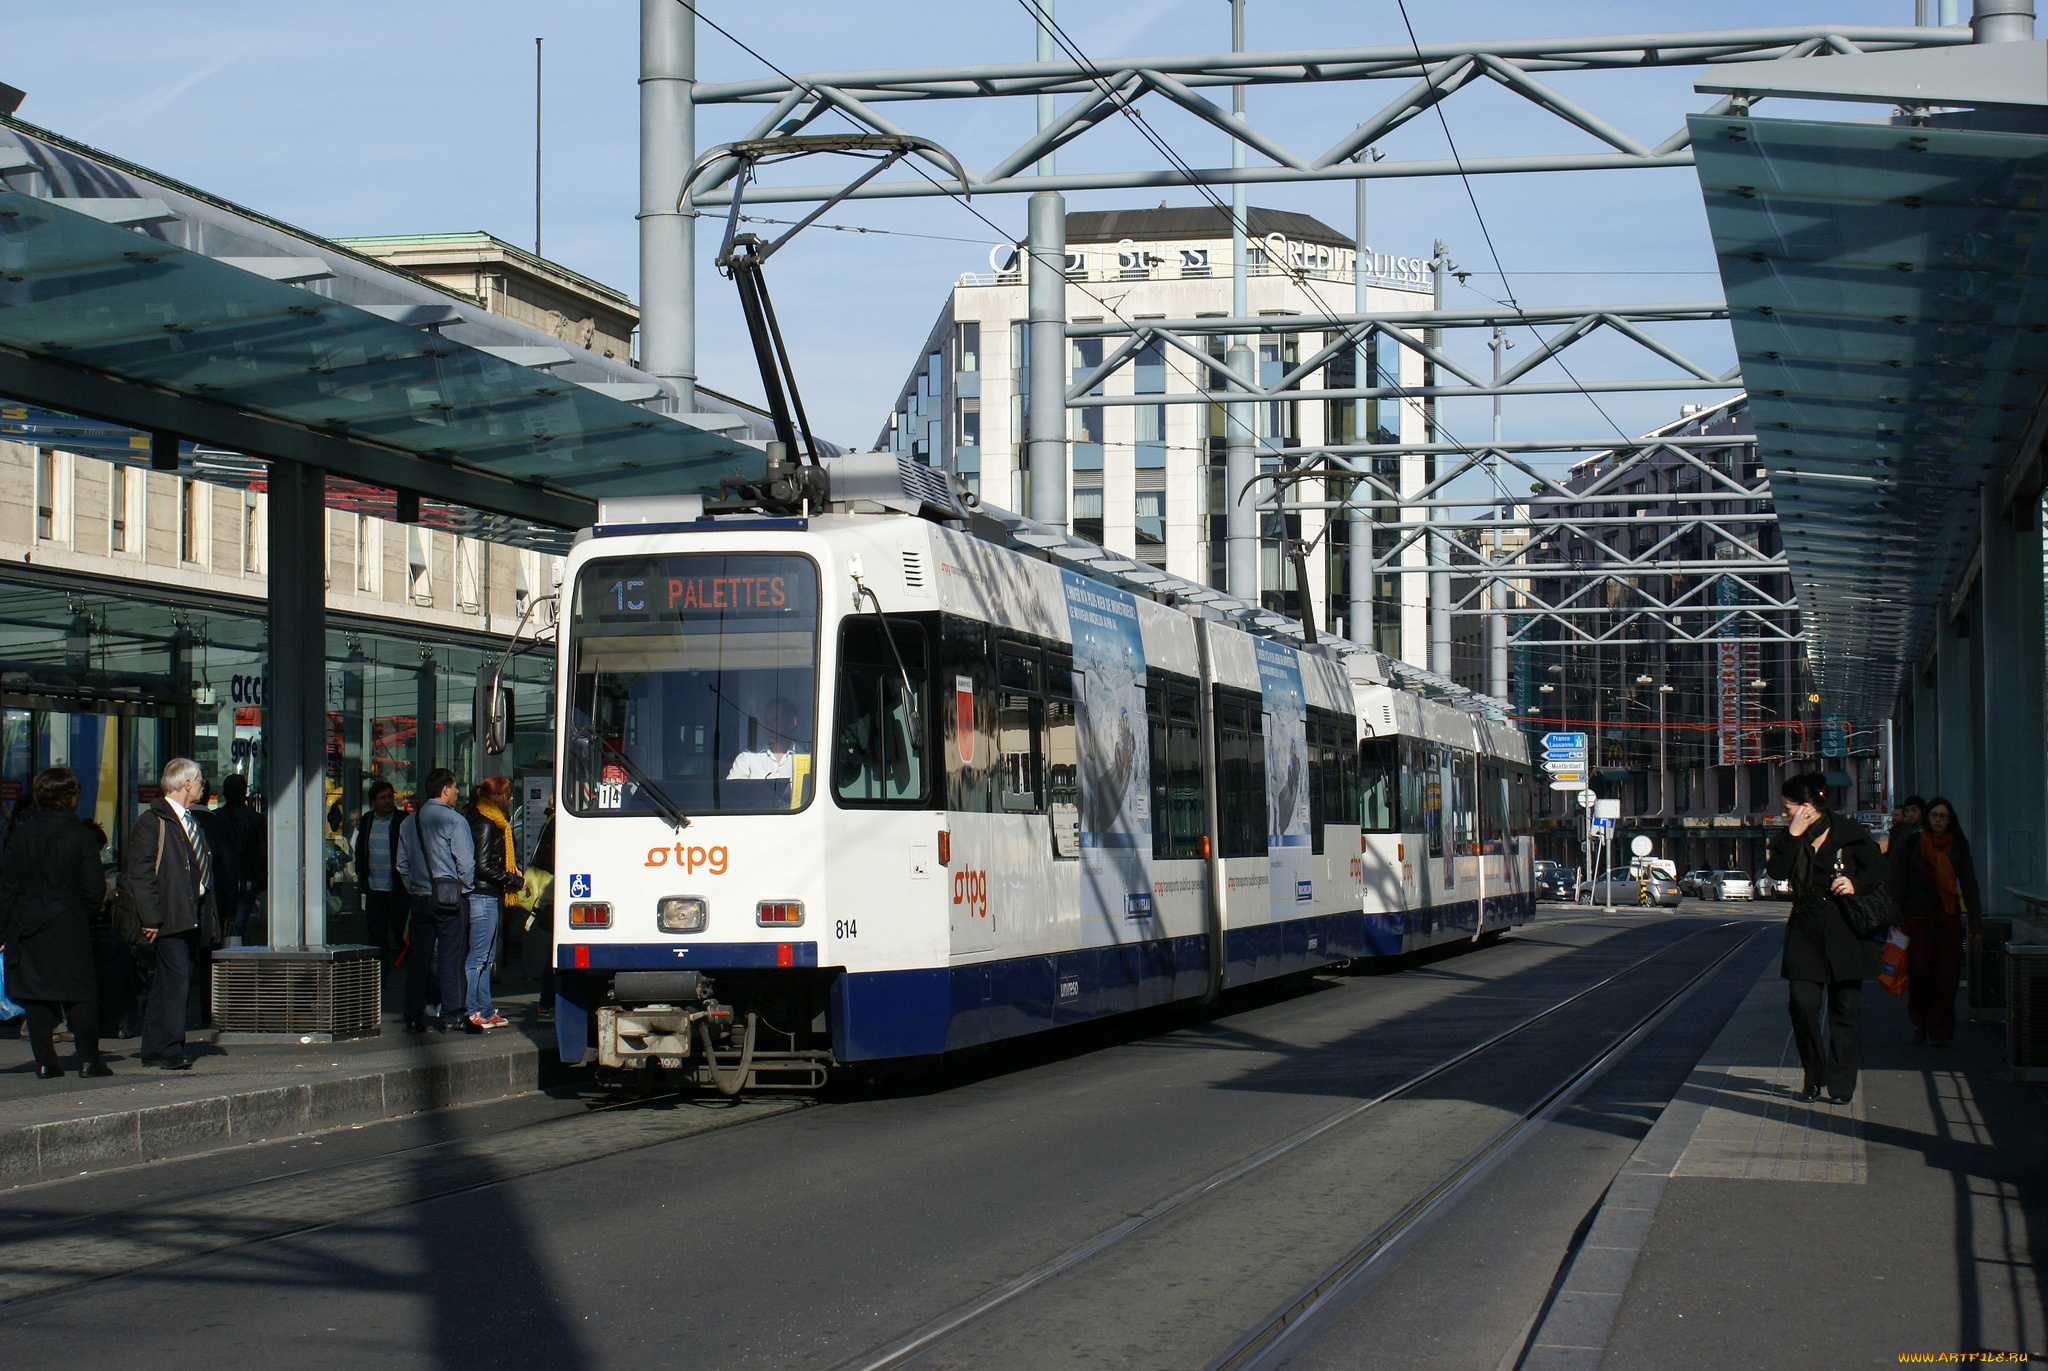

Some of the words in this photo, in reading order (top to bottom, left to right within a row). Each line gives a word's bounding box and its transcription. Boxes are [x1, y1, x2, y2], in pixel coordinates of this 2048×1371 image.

[989, 244, 1110, 273] CDIT
[1264, 232, 1354, 271] CREDIT
[609, 580, 645, 610] 15
[668, 576, 786, 609] PALETTES
[1514, 676, 1525, 731] ommercial
[1808, 694, 1820, 703] 40
[1822, 712, 1838, 757] Centr
[673, 842, 728, 875] tpg
[964, 863, 987, 918] tpg
[836, 919, 858, 940] 814
